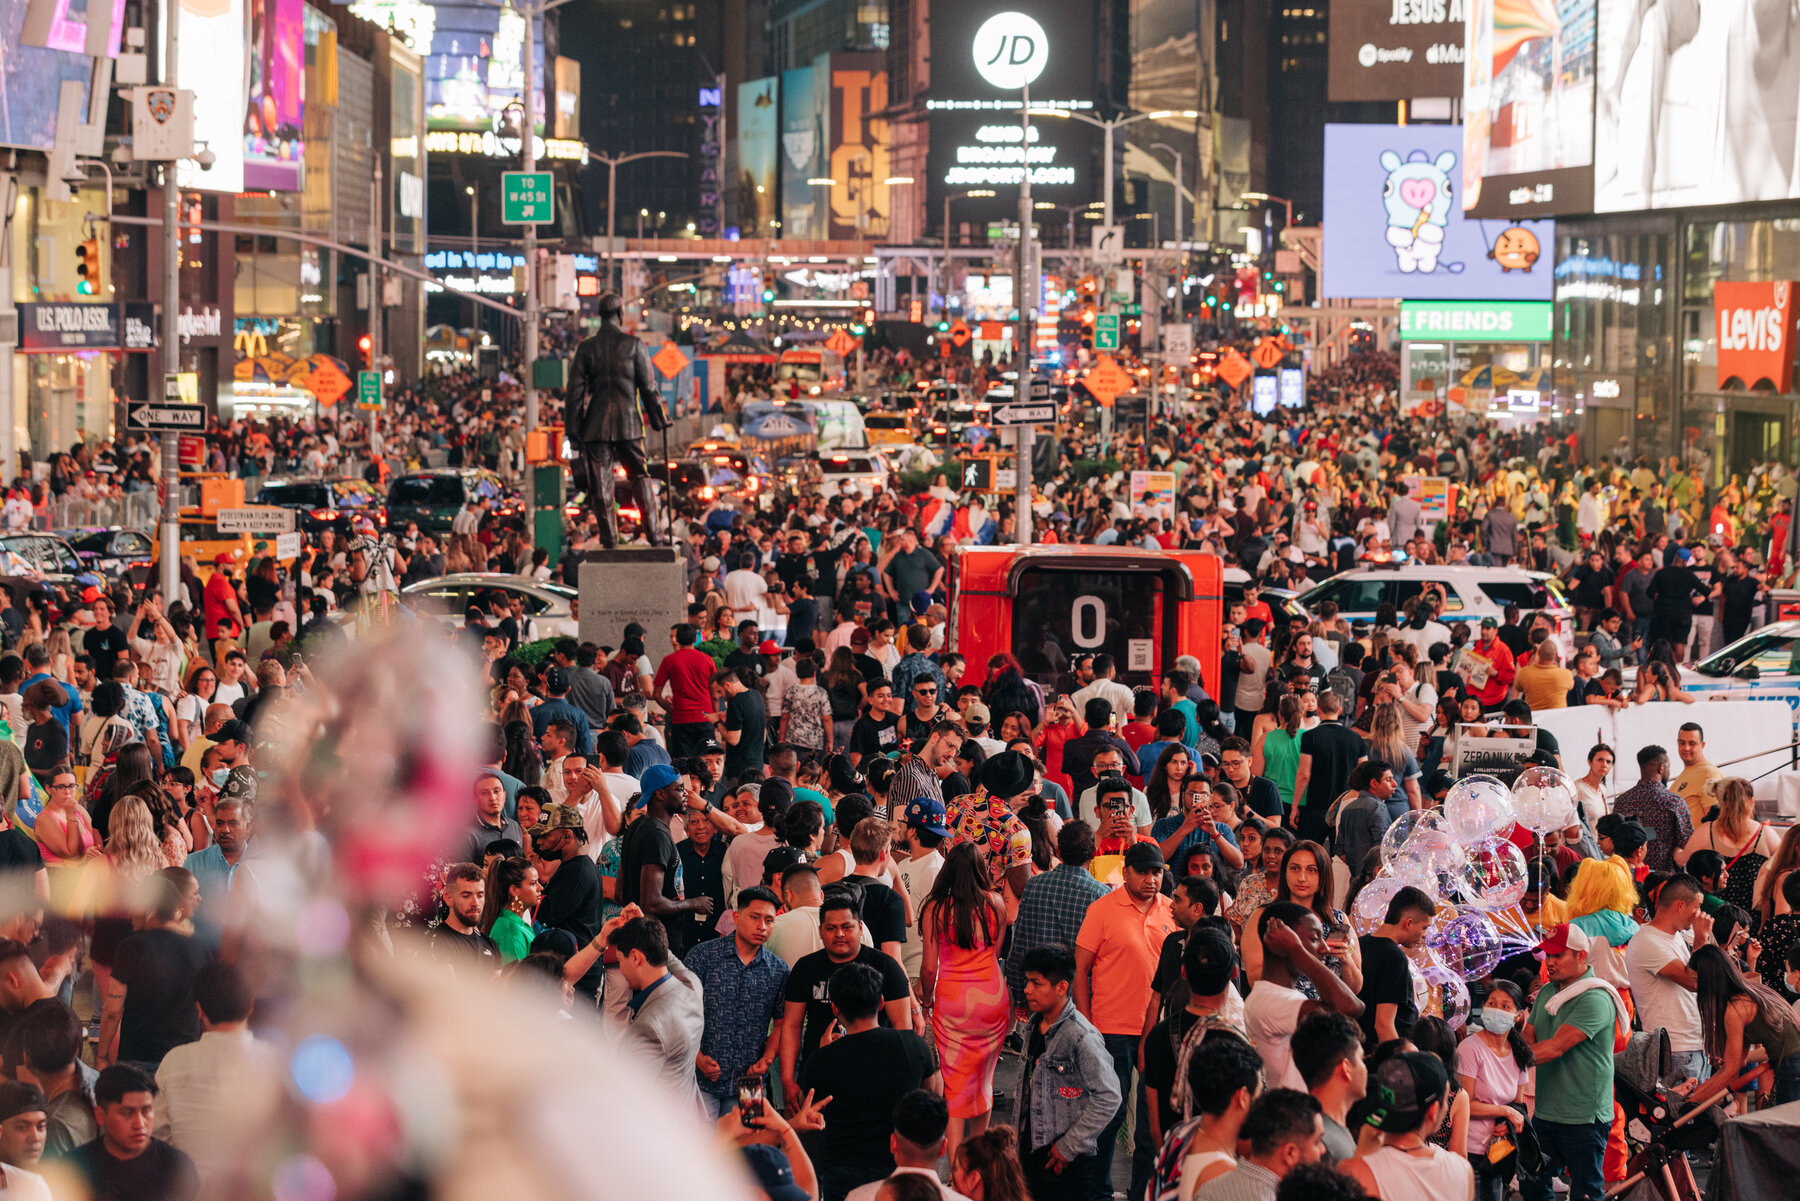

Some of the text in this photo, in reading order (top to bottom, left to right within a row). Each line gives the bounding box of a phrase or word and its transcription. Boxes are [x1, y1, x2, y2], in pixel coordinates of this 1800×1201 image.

[987, 35, 1035, 66] JD
[1377, 47, 1413, 63] Spotify
[956, 146, 1057, 163] BROADWAY
[520, 177, 535, 189] TO
[520, 191, 534, 202] 45
[36, 306, 110, 331] U.S. POLO ASSN.
[1415, 310, 1513, 331] FRIENDS
[1169, 341, 1188, 353] 25
[139, 410, 196, 422] ONE WAY
[1000, 411, 1018, 419] ONE
[220, 511, 253, 519] PEDESTRIAN
[249, 521, 285, 529] KEEP MOVING
[1071, 595, 1107, 649] 0
[1463, 750, 1490, 763] ZERO
